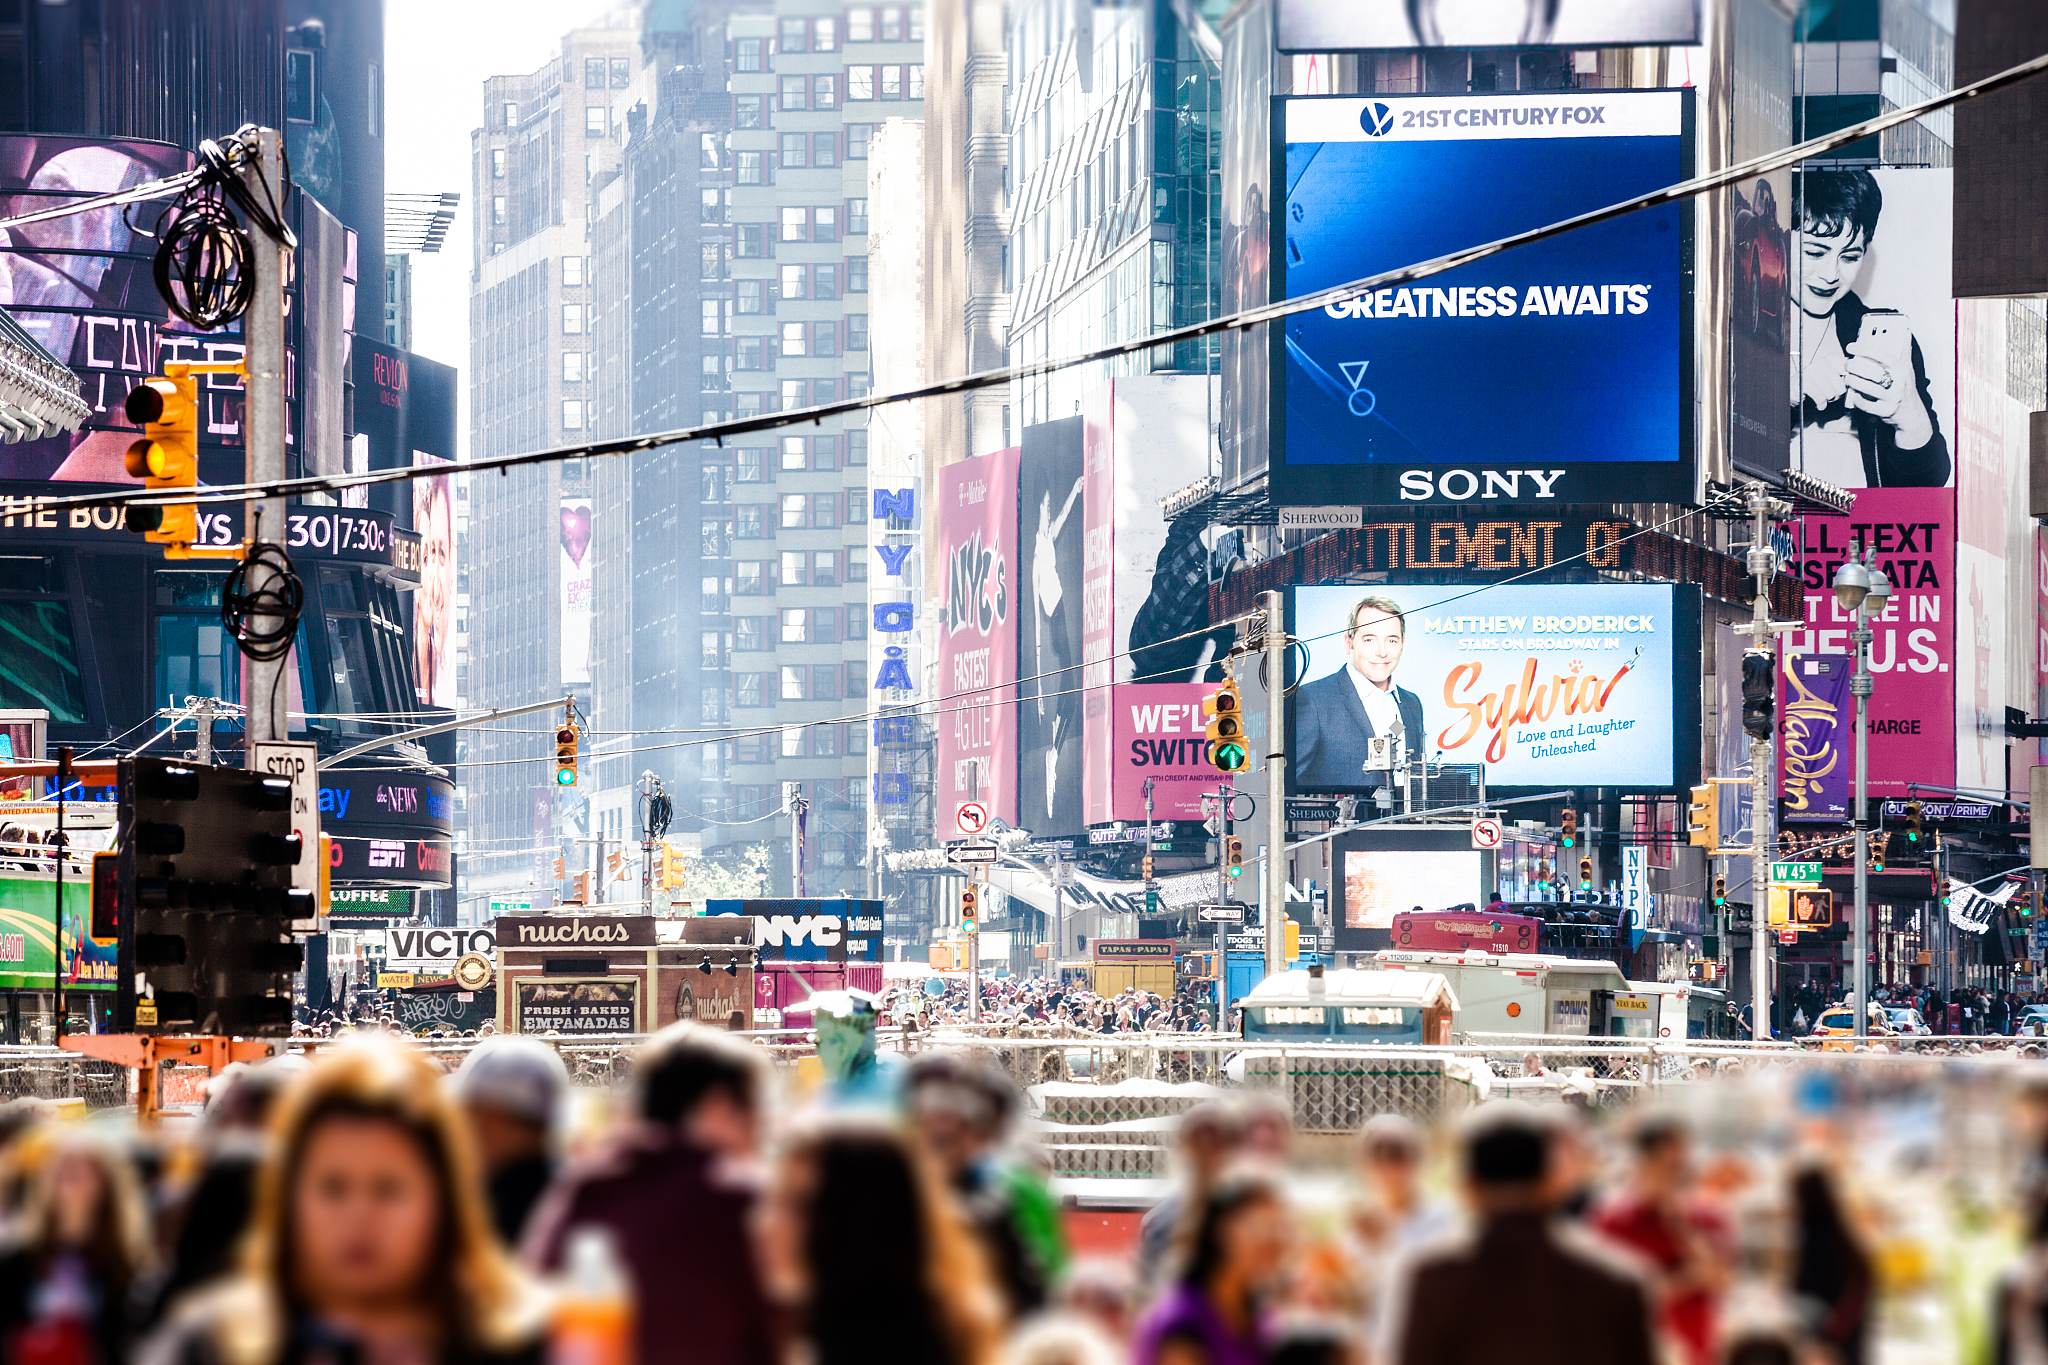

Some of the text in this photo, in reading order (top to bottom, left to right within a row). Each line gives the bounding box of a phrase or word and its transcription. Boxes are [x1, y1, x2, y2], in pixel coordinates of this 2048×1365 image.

[1402, 106, 1605, 128] 21ST CENTURY FOX
[1324, 284, 1649, 320] GREATNESS AWAITS
[374, 352, 408, 392] REVLON
[1399, 470, 1566, 500] SONY
[1282, 512, 1359, 524] SHERWOOD
[1851, 523, 1940, 553] TEXT
[395, 538, 409, 570] THE
[1876, 560, 1940, 588] ATA
[1831, 595, 1899, 622] LE
[1910, 595, 1940, 622] IN
[1424, 615, 1654, 634] MATTHEW BRODERICK
[1458, 638, 1620, 651] STARS ON BROADWAY IN
[1775, 630, 1847, 673] HE
[1868, 628, 1949, 673] U.S.
[954, 647, 990, 692] FASTEST
[954, 696, 991, 750] 4G LTE
[1131, 704, 1208, 733] WE'L
[1437, 657, 1630, 763] Sylvia
[1517, 718, 1636, 744] Love and Laughter
[1531, 739, 1597, 759] Unleashed
[267, 757, 305, 785] STOP
[954, 756, 991, 791] NETORK
[294, 797, 308, 814] ON
[388, 786, 418, 813] NEWS
[1828, 804, 1845, 812] Disney
[1888, 804, 1988, 816] OUONT PRIME
[1140, 828, 1162, 839] PRME
[368, 841, 406, 868] ESPN
[1776, 863, 1817, 879] W 45 St
[330, 890, 390, 902] COFFEE
[1628, 850, 1639, 926] NYPD
[519, 918, 629, 943] nuchas
[755, 915, 841, 946] NYC
[847, 916, 882, 931] The Official Guide
[1435, 920, 1449, 931] City
[391, 930, 496, 957] VICTO
[1492, 943, 1508, 952] 71510
[381, 976, 411, 984] WATER
[417, 975, 444, 984] NEWS
[524, 1006, 630, 1015] FRESH BAKED
[696, 988, 734, 1019] nuchas
[523, 1017, 630, 1029] EMPANADAS
